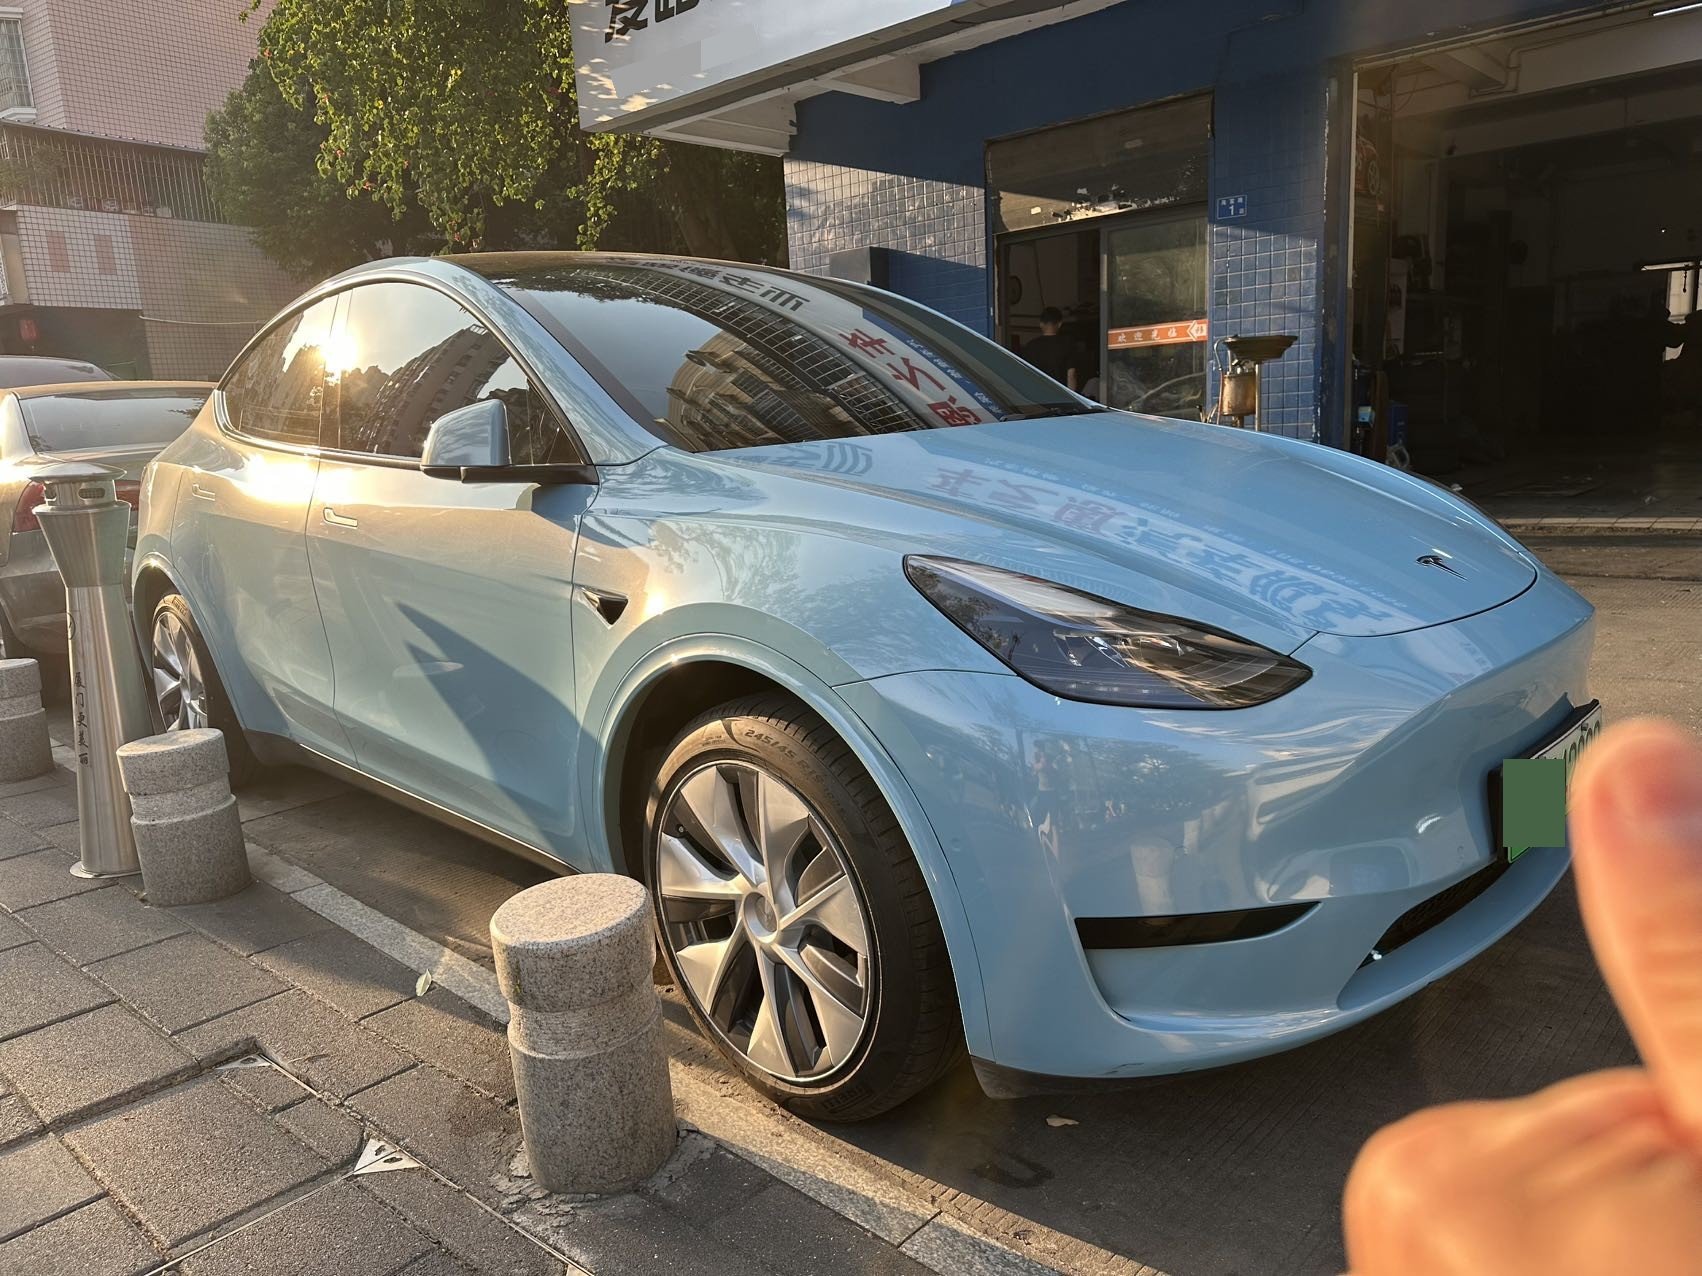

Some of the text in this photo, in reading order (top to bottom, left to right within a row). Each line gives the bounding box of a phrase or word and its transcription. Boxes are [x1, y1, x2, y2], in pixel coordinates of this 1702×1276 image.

[1118, 327, 1178, 344] 欢迎光临
[73, 671, 90, 766] 厦门更美丽
